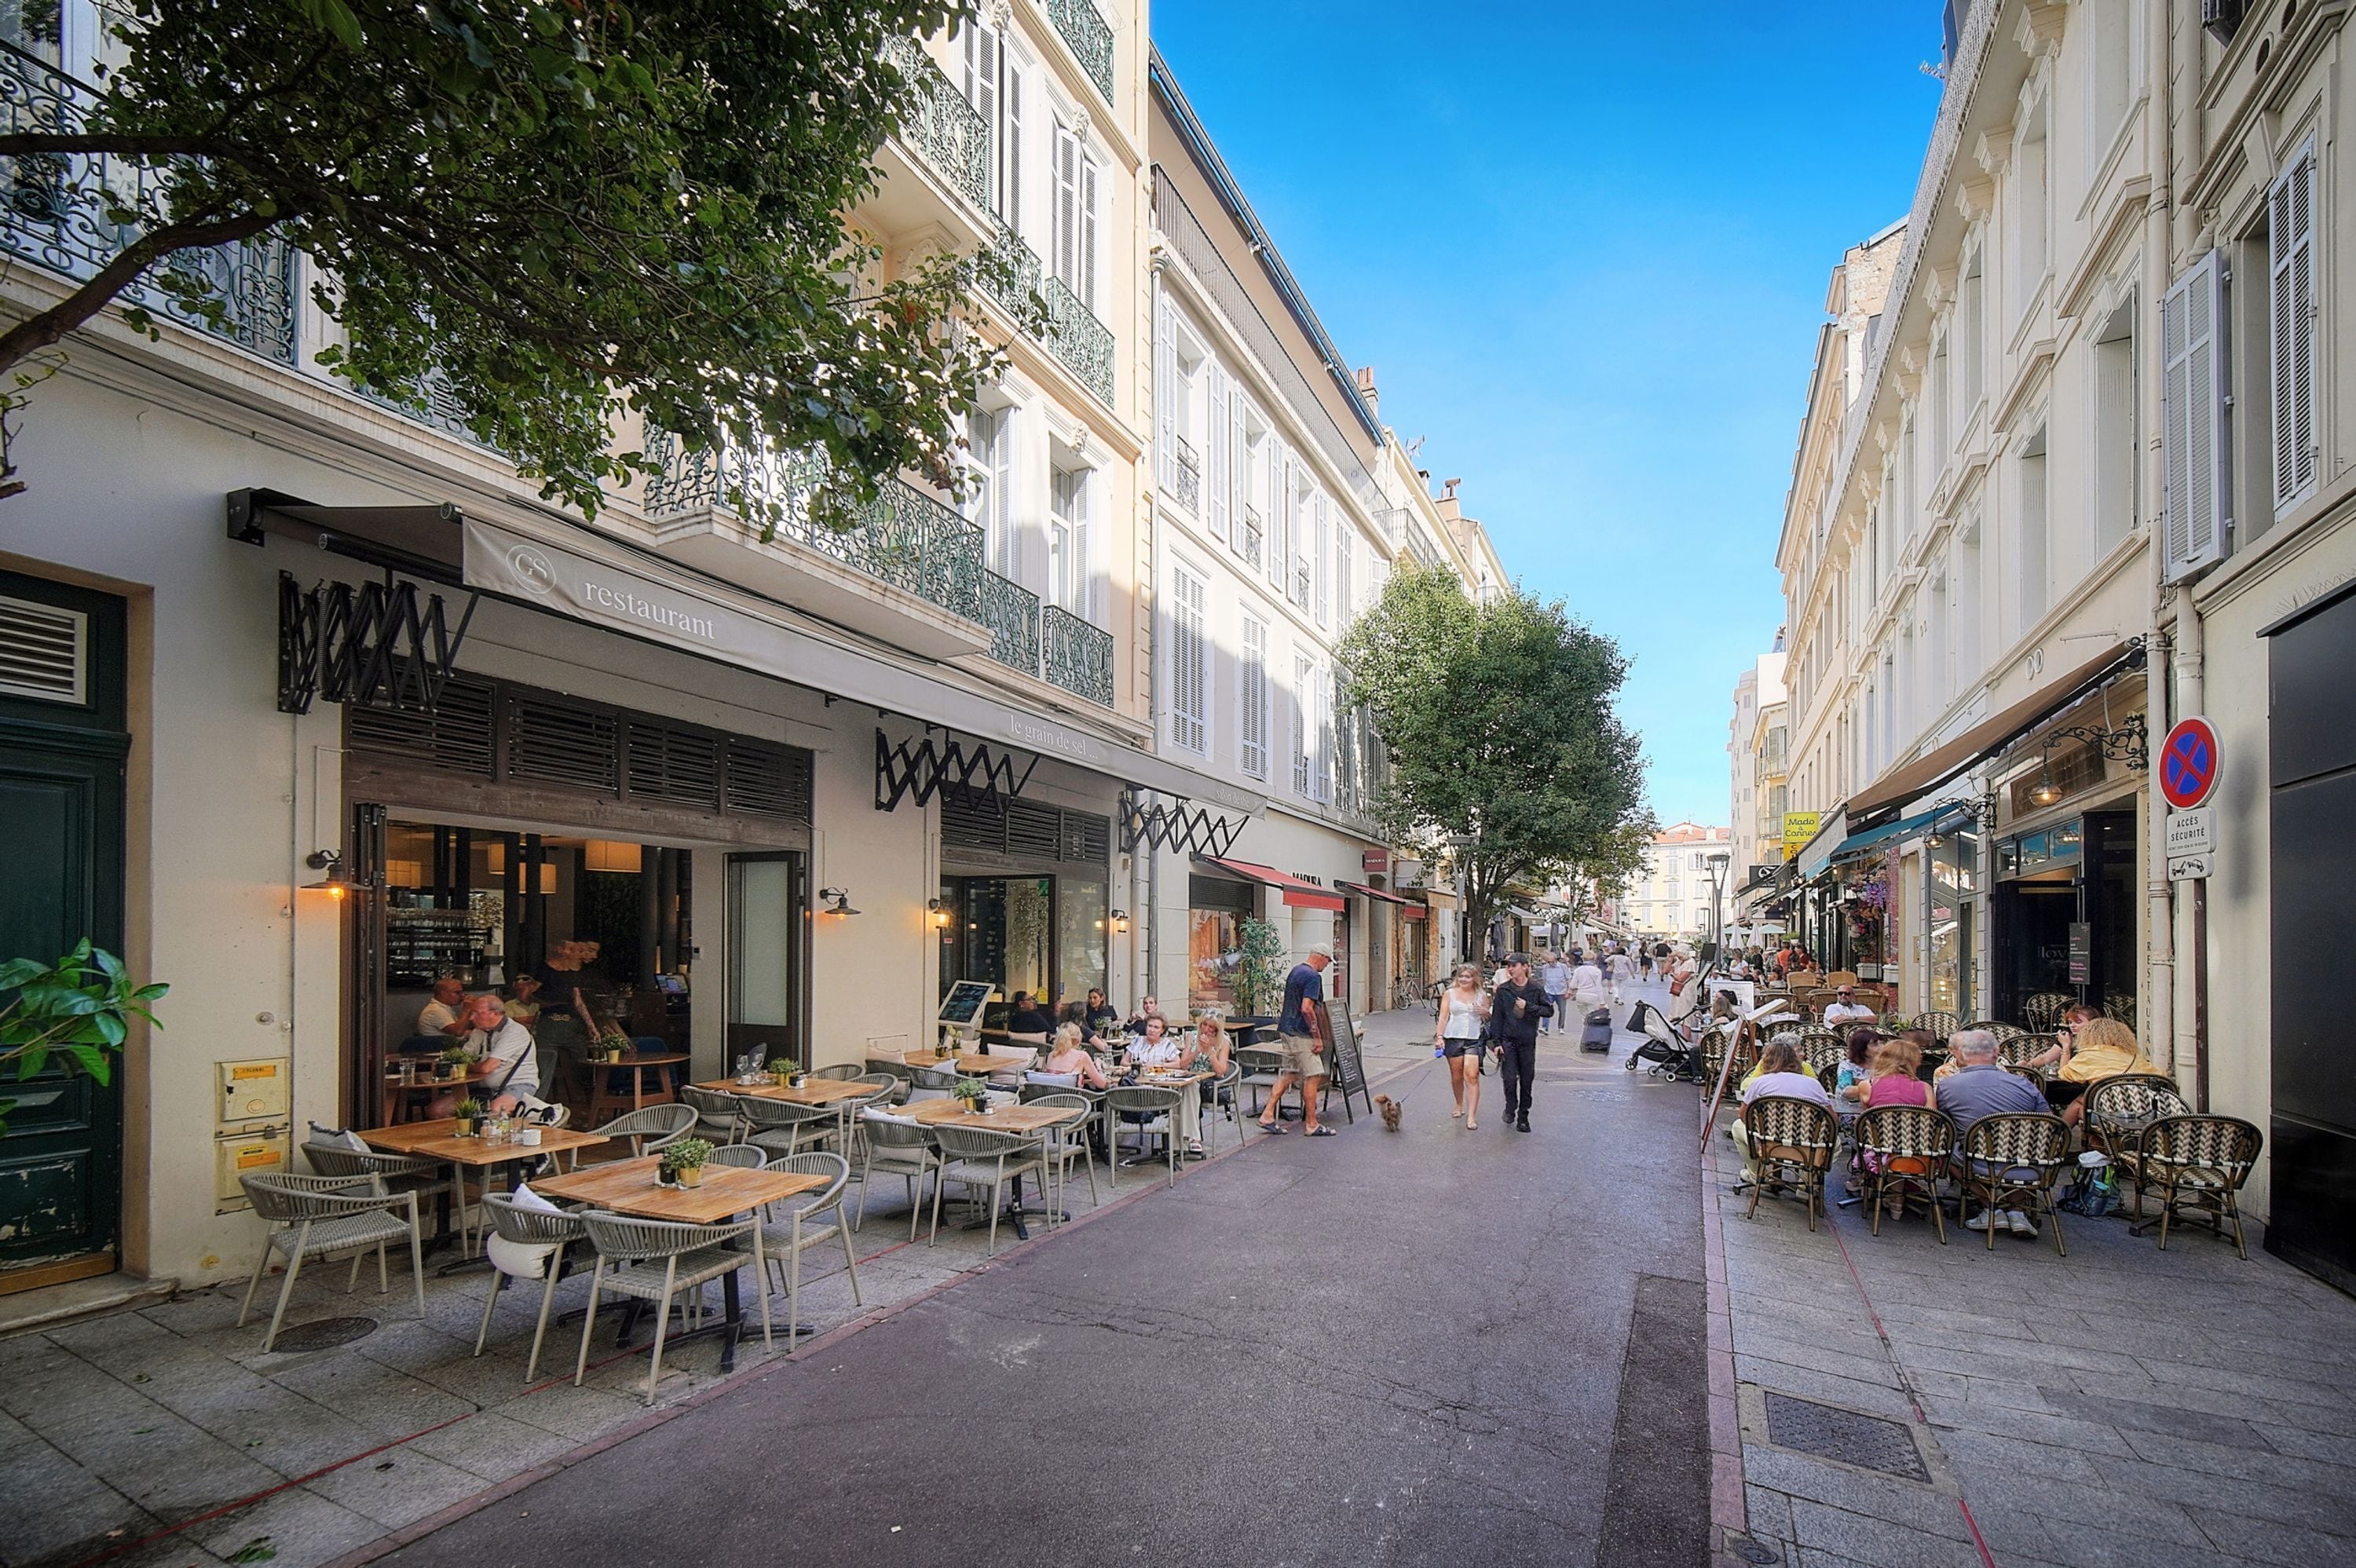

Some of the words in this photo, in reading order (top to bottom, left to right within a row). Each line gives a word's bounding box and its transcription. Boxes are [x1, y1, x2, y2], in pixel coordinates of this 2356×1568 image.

[515, 554, 547, 579] GS
[584, 581, 716, 640] restaurant
[1010, 715, 1022, 734] le
[1024, 726, 1054, 745] grain
[1056, 732, 1070, 750] de
[1072, 740, 1086, 755] sel
[1787, 817, 1815, 826] Mado
[2176, 815, 2199, 828] ACCÈS
[2171, 826, 2205, 842] SÉCURITÉ
